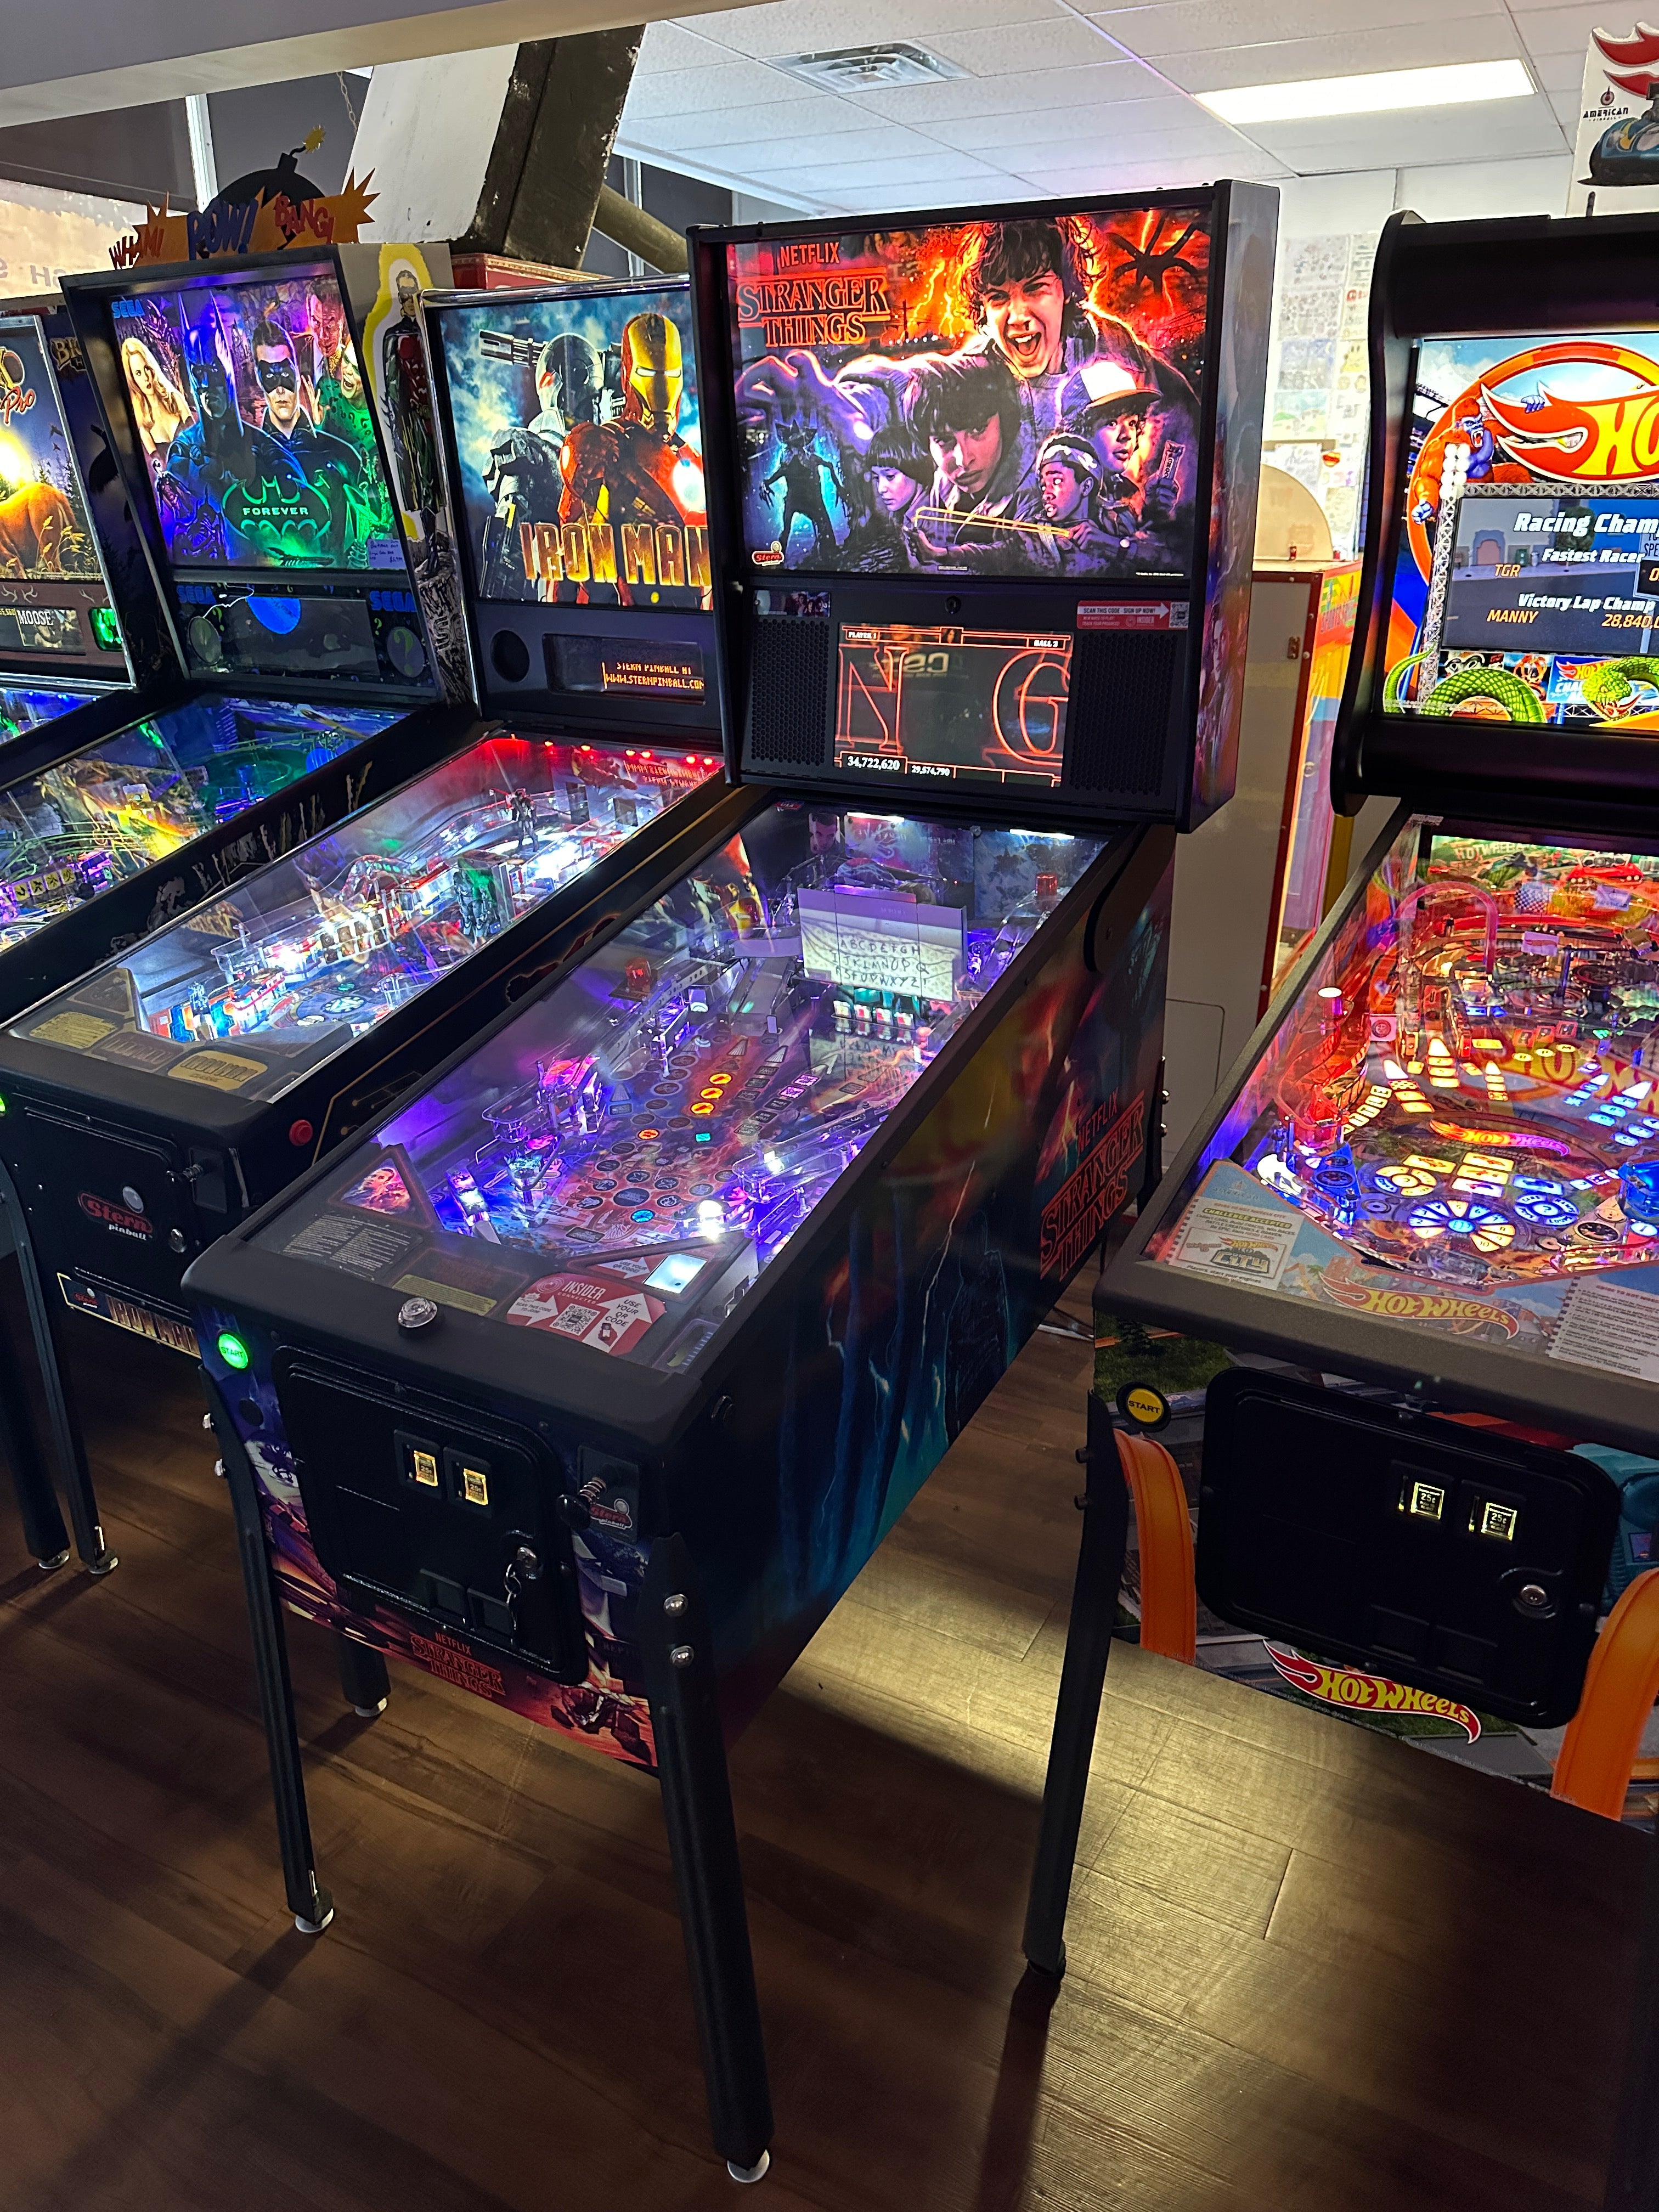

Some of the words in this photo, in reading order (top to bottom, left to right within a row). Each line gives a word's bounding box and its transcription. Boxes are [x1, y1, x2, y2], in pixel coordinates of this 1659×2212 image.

[1583, 108, 1628, 118] AMERICAN
[187, 198, 258, 261] POW!
[780, 242, 840, 267] NETFLIX
[737, 275, 890, 322] STRANGER
[111, 299, 145, 319] SEGA
[763, 312, 866, 347] THINGS
[242, 507, 308, 515] FOREVER
[1514, 512, 1591, 537] Racing
[1594, 513, 1659, 535] Cham
[520, 522, 618, 583] IRON
[621, 524, 712, 587] MAN
[1542, 548, 1597, 563] Fastest
[1599, 549, 1645, 564] Racer
[1494, 564, 1521, 577] TGR
[177, 585, 216, 604] SEGA
[1518, 594, 1572, 611] Victory
[1573, 595, 1601, 612] Lap
[1603, 597, 1656, 614] Champ
[16, 610, 53, 625] MOOSE
[1487, 610, 1539, 624] MANNY
[847, 755, 900, 771] 34,722,620
[911, 765, 950, 777] 29,574,790
[1078, 1087, 1119, 1155] NETFLIX
[1041, 1099, 1144, 1265] STRANGER
[87, 1199, 149, 1232] Stern
[1058, 1166, 1128, 1282] THINGS
[1203, 1207, 1249, 1221] CHALLENGE
[1249, 1217, 1292, 1229] ACCEPTED
[109, 1223, 146, 1240] pinball
[631, 1263, 647, 1272] YOUR
[557, 1292, 597, 1305] CONNECTED
[561, 1280, 606, 1300] INSIDER
[616, 1303, 639, 1314] YOUR
[624, 1299, 641, 1308] USE
[605, 1316, 629, 1328] CODE
[615, 1312, 629, 1320] QR
[221, 1346, 244, 1358] START
[1128, 1400, 1160, 1413] START
[1421, 1492, 1436, 1504] 25¢
[1492, 1513, 1507, 1525] 25¢
[436, 1632, 472, 1656] NETFLIX
[411, 1635, 505, 1695] STRANGER
[429, 1657, 493, 1699] THINGS
